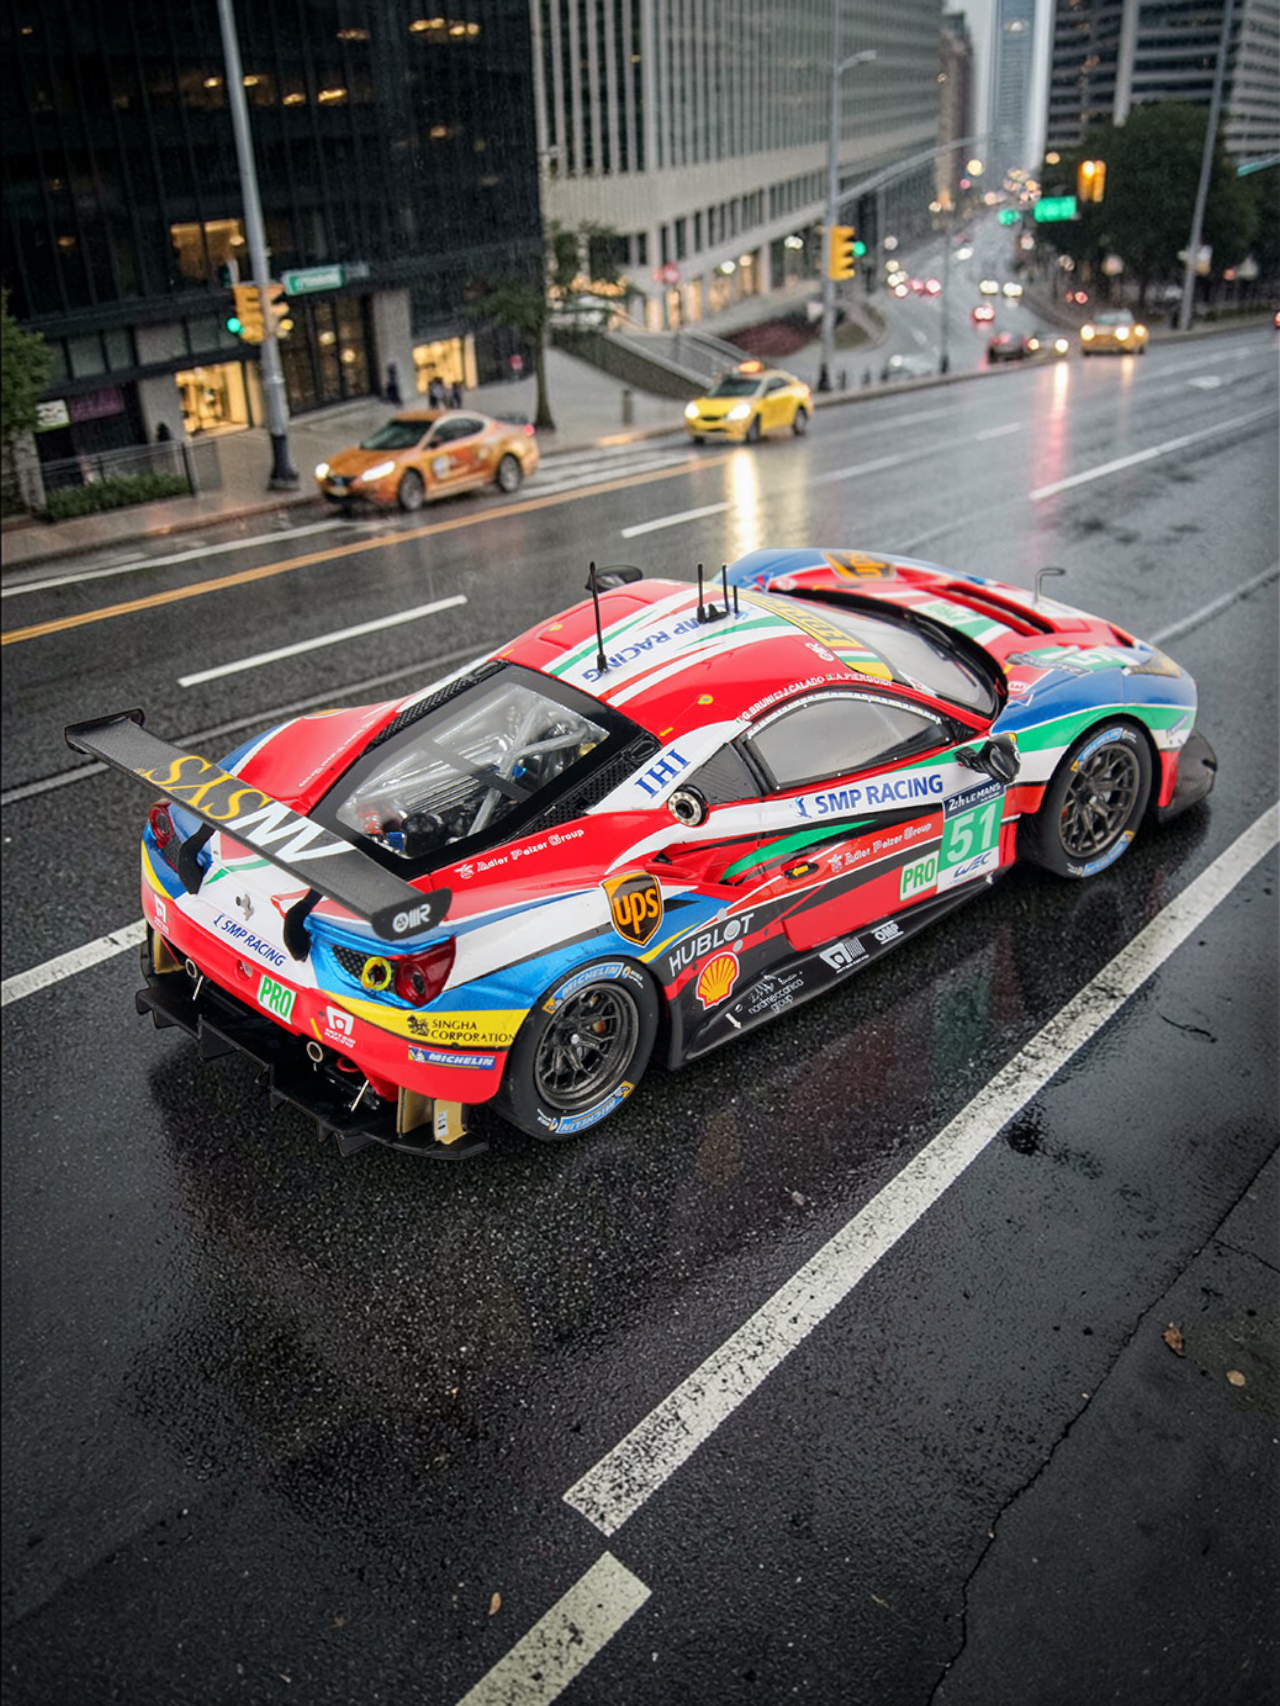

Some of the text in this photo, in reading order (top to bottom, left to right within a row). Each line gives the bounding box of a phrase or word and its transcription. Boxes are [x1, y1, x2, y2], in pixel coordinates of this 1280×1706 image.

[634, 749, 691, 799] IHI
[815, 774, 943, 814] SMP RACING
[477, 828, 584, 872] Adler Pelzer Group
[947, 803, 997, 863] 51
[902, 858, 936, 894] PRO
[613, 888, 659, 934] ups
[220, 920, 286, 967] SMP RACING
[668, 913, 755, 976] HUBLOT
[259, 978, 292, 1017] PRO
[561, 965, 620, 997] MICHELIN
[431, 1018, 477, 1030] SINGHA
[428, 1052, 494, 1066] MICHELIN
